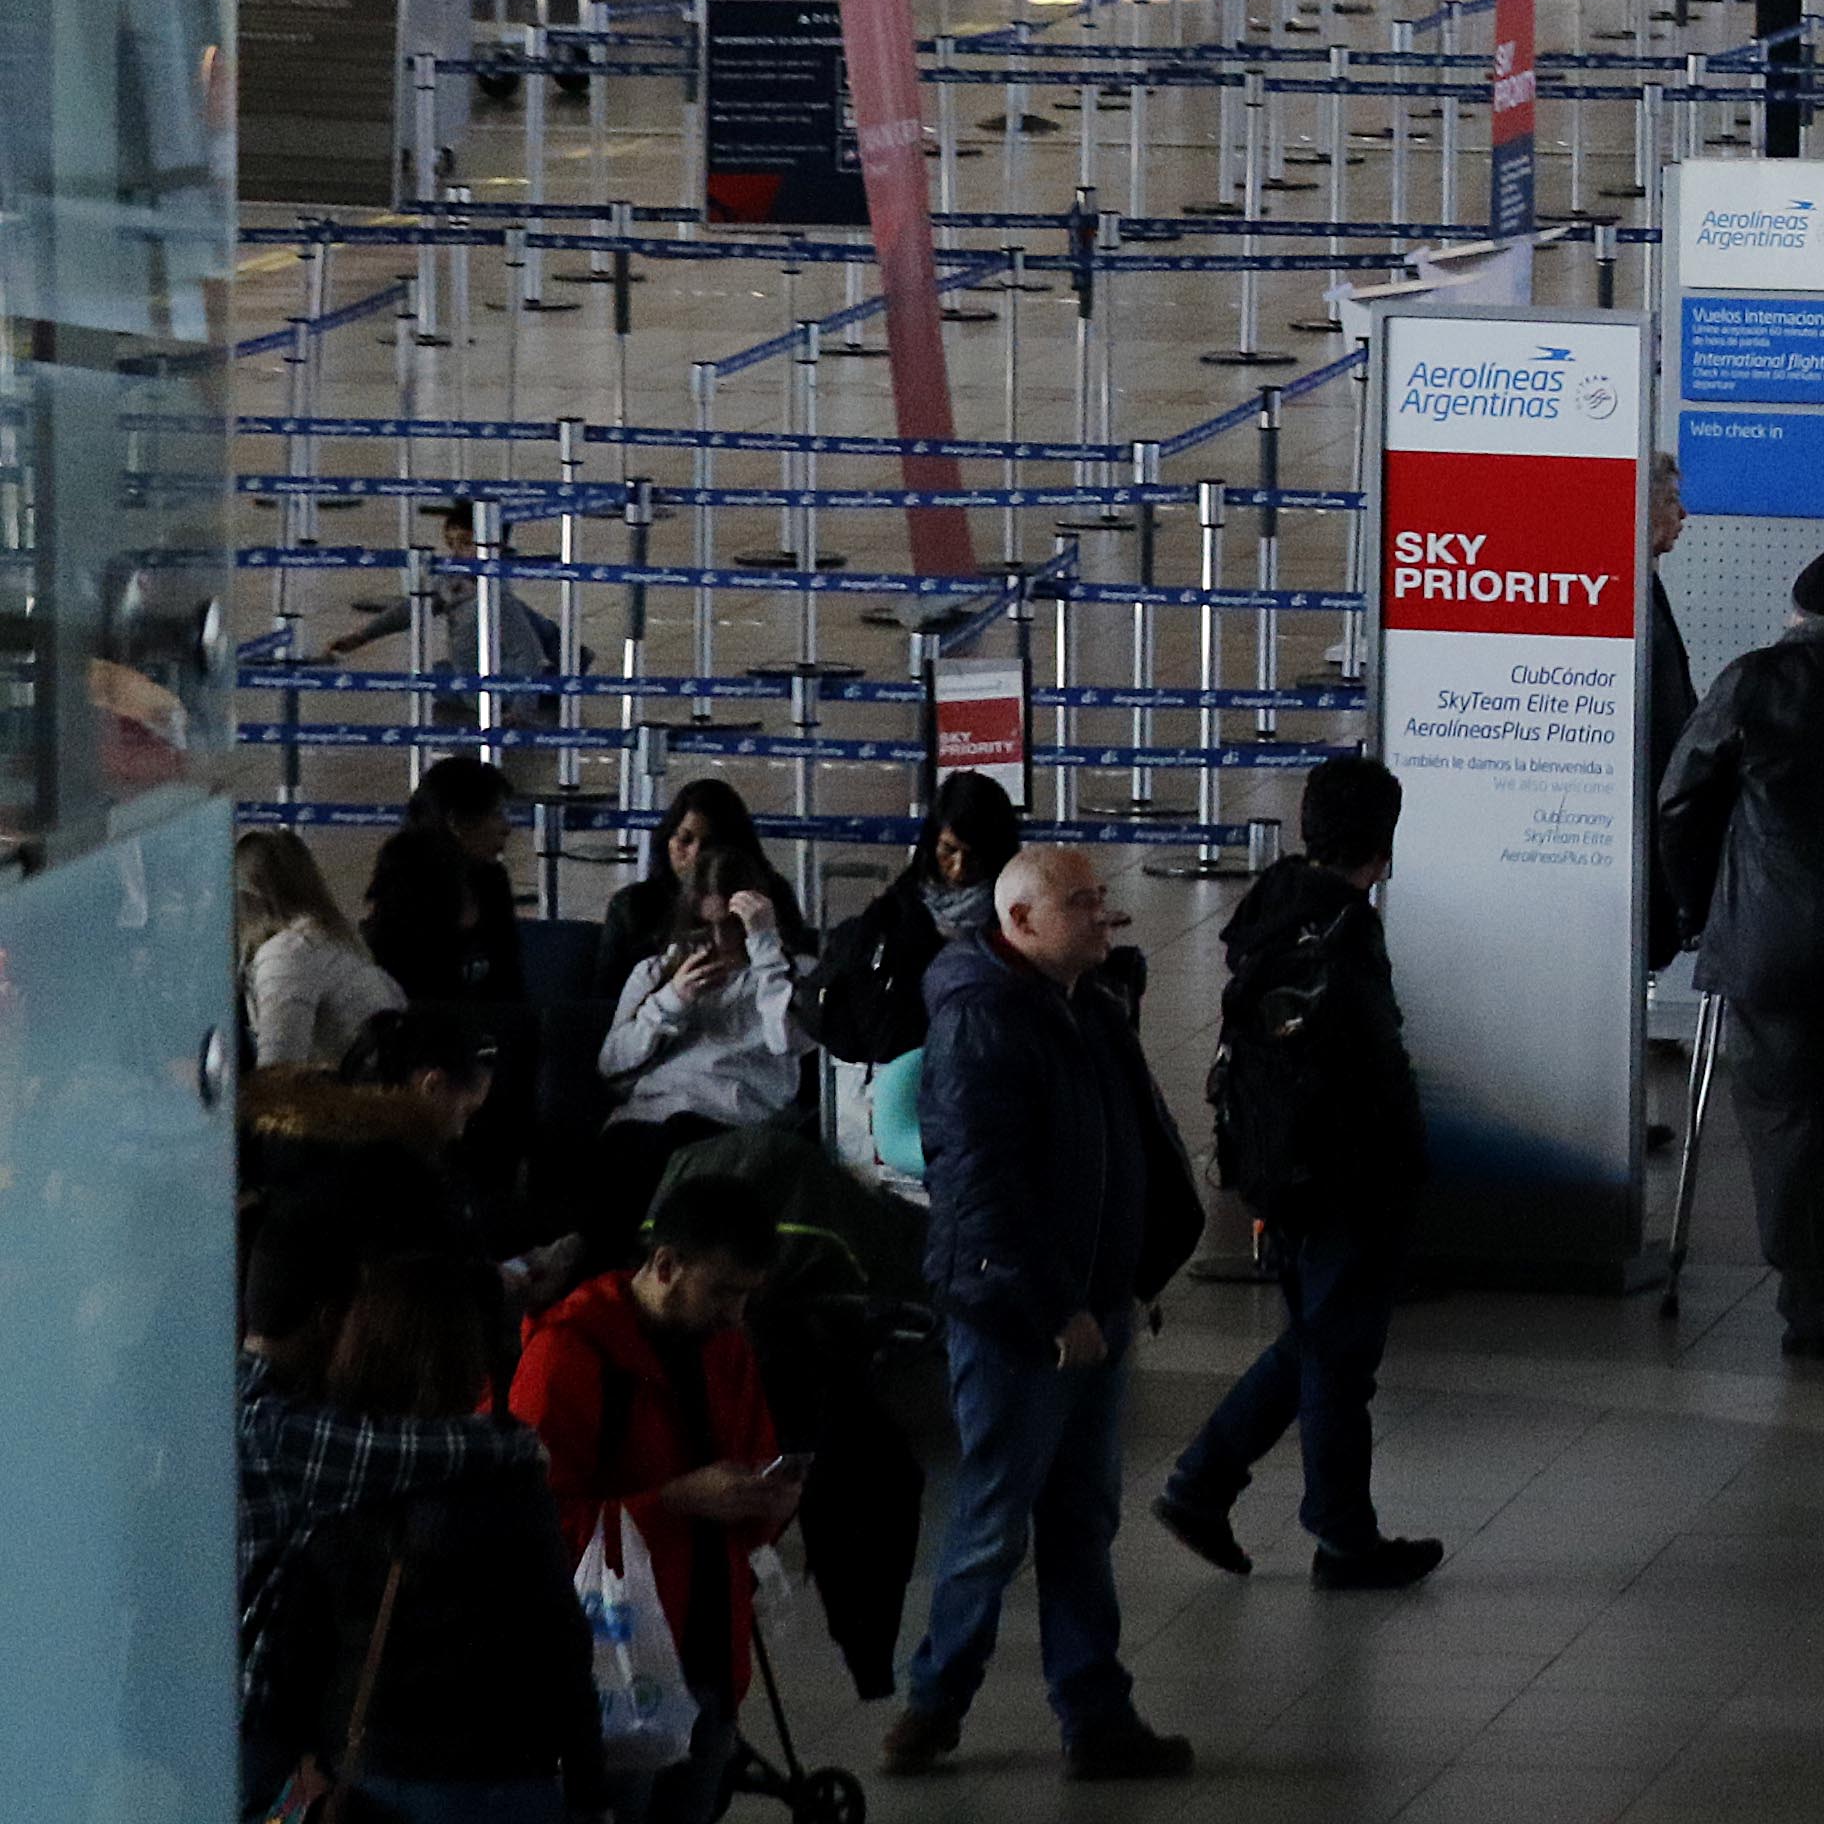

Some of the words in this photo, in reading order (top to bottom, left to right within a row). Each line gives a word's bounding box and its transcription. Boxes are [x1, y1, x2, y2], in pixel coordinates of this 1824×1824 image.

[1702, 209, 1809, 231] Aerolíneas
[1696, 228, 1805, 250] Argentinas
[1692, 307, 1742, 323] Vuelos
[1693, 351, 1786, 369] International
[1406, 361, 1566, 393] Aerolíneas
[1400, 388, 1560, 422] Argentinas
[1690, 420, 1723, 436] Web
[1725, 423, 1766, 439] check
[1769, 424, 1784, 439] in
[1394, 531, 1487, 565] SKY
[1394, 567, 1609, 606] PRIORITY
[1511, 664, 1616, 687] ClubCóndor
[1438, 690, 1520, 714] SkyTeam
[1527, 693, 1570, 714] Elite
[1575, 695, 1616, 716] Plus
[1403, 717, 1541, 742] AerolíneasPlus
[1546, 723, 1616, 745] Platino
[1393, 752, 1449, 769] También
[1452, 755, 1464, 769] le
[1467, 755, 1511, 771] damos
[1514, 757, 1527, 772] la
[1529, 757, 1602, 775] bienvenida
[1605, 764, 1614, 775] a
[1524, 829, 1581, 848] SkyTeam
[1583, 830, 1613, 845] Elite
